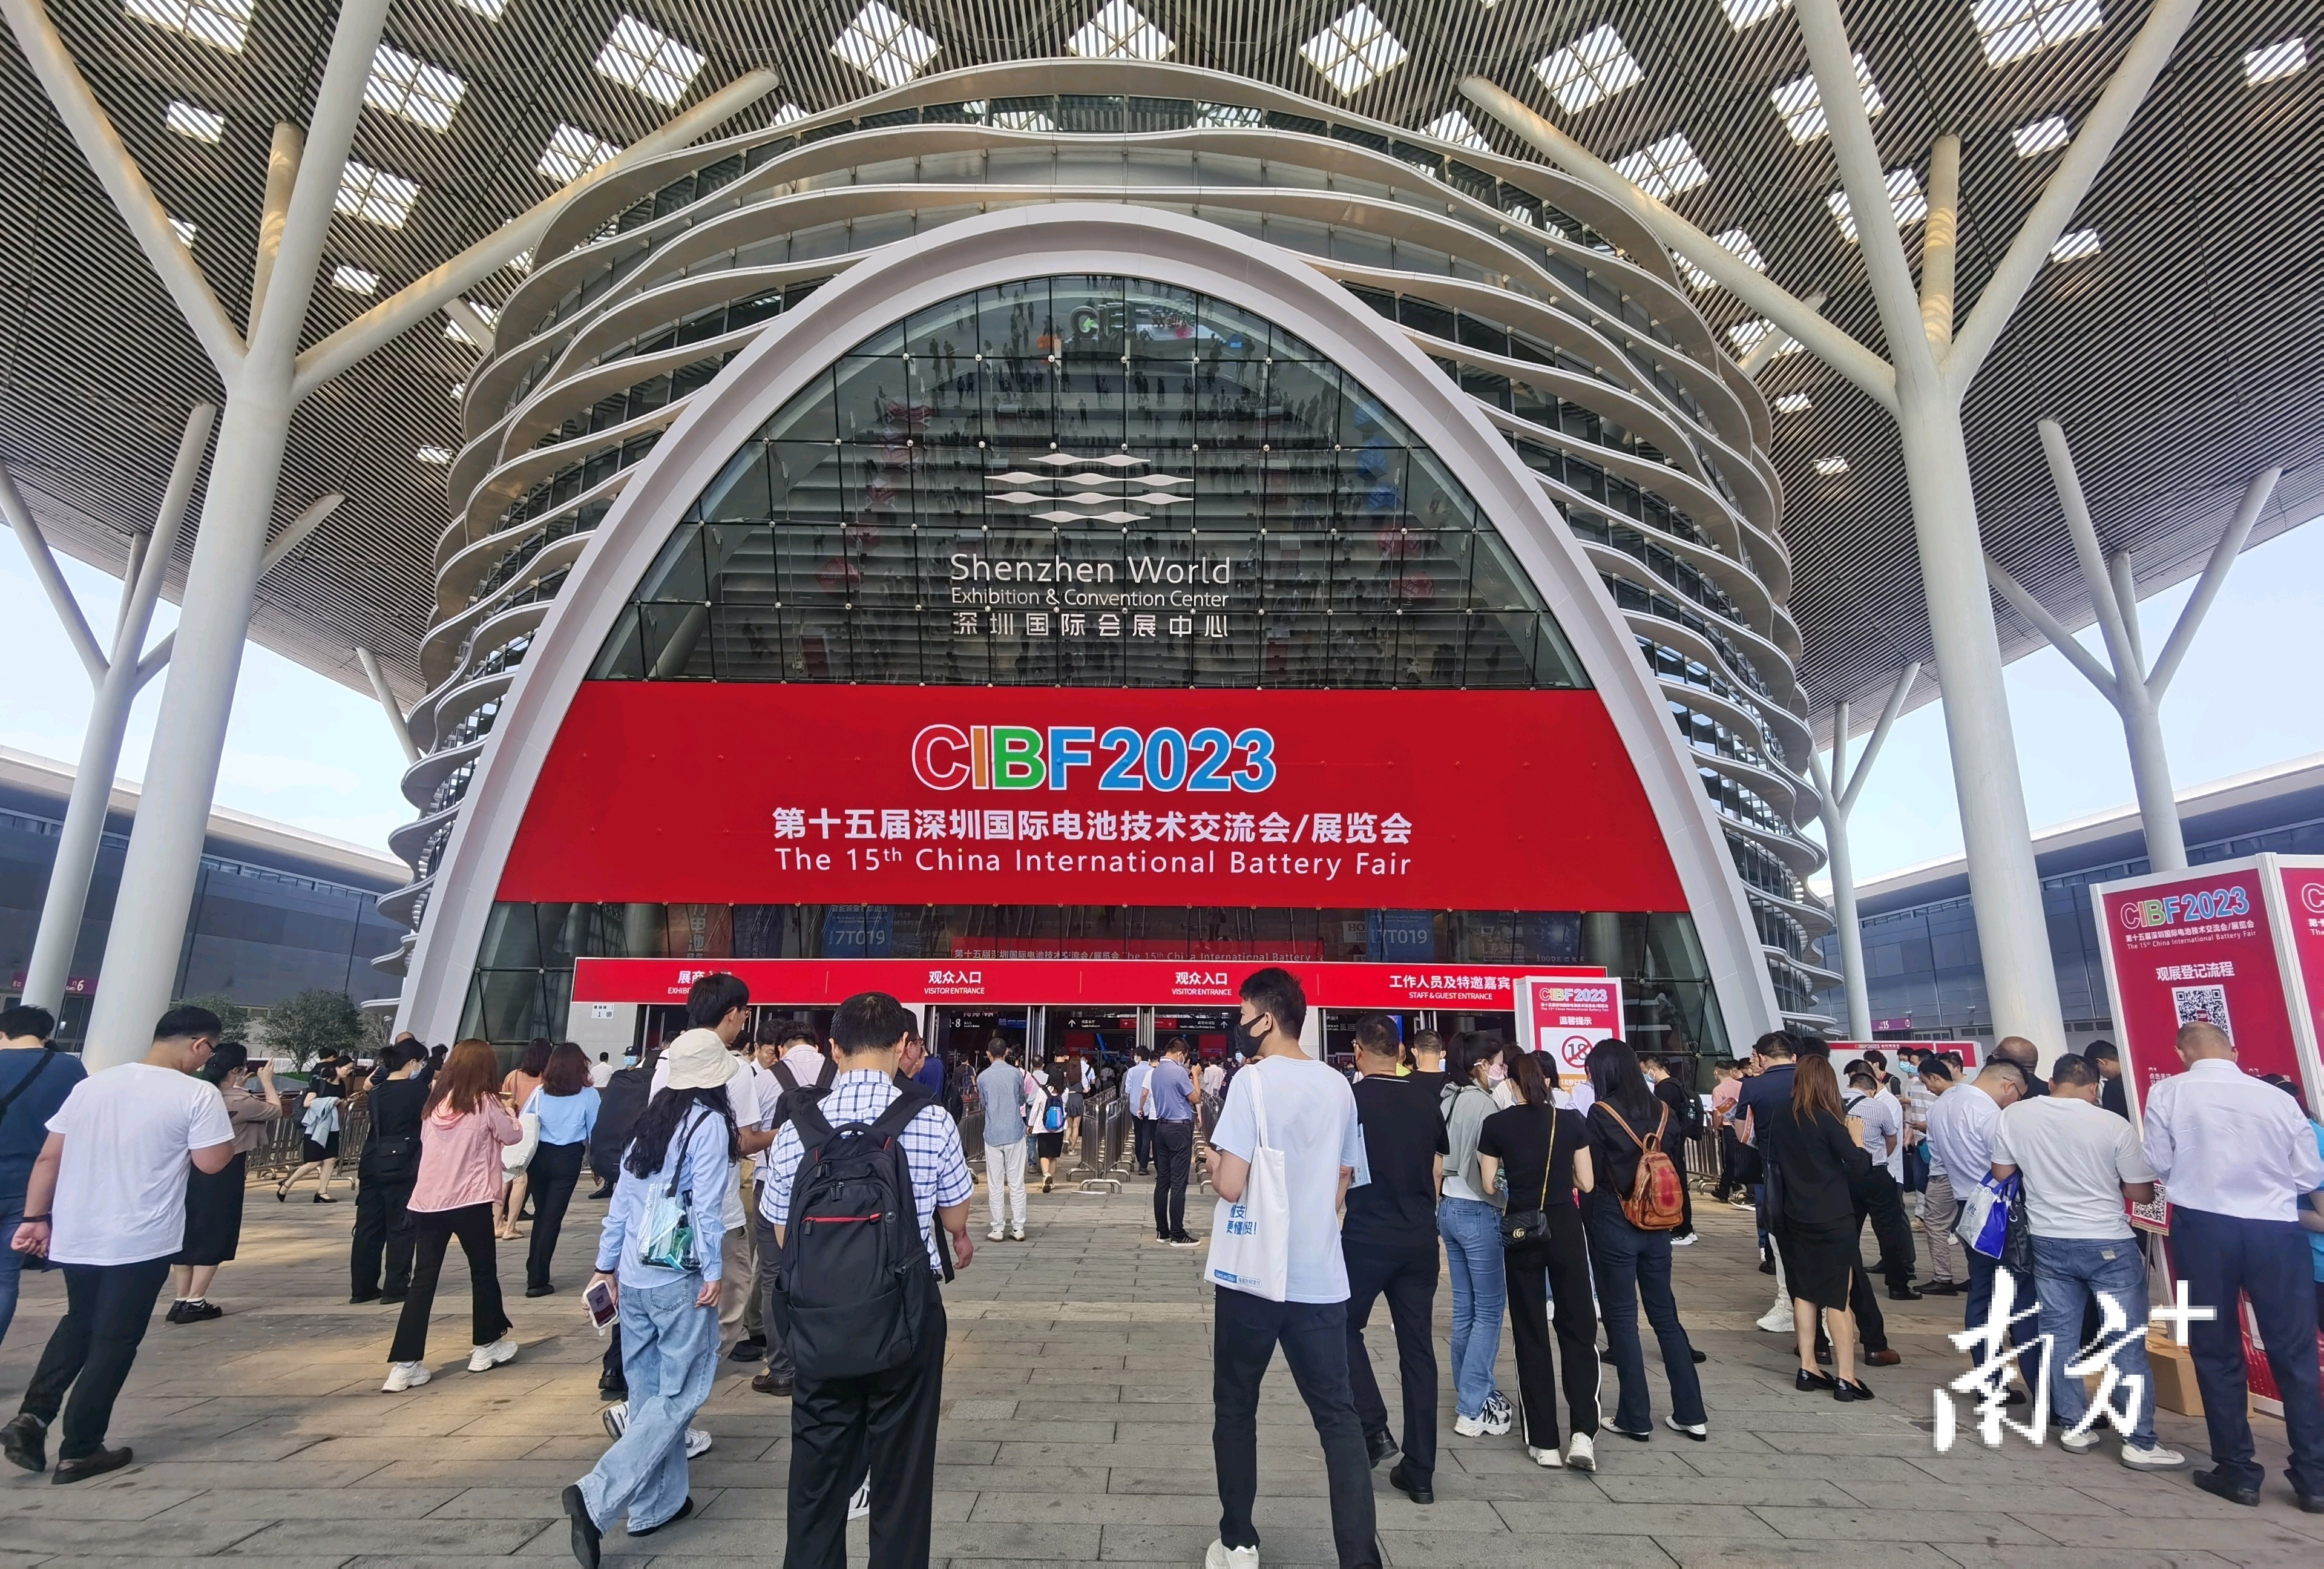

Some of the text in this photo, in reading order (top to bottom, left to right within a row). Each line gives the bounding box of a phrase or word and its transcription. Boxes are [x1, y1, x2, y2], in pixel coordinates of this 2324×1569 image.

[950, 553, 1230, 584] Shenzhen World
[951, 587, 1229, 607] Exhibition & Convention Center
[953, 612, 1229, 638] 深圳国际会展中心
[912, 724, 1277, 793] CIBF2023
[772, 807, 1413, 845] 第十五届深圳国际电池技术交流会/展览会
[775, 847, 1411, 881] The 15th China International Battery Fair
[2120, 886, 2250, 929] CIBF2023
[835, 930, 885, 946] 7T019
[2171, 935, 2214, 945] International
[2216, 932, 2240, 940] Battery
[1122, 952, 1140, 960] he
[1167, 952, 1196, 961] Chia
[1201, 952, 1269, 961] International
[928, 970, 982, 984] 观众入口
[1175, 972, 1228, 985] 观众入口
[2156, 961, 2235, 982] 观展登记流程
[77, 980, 84, 991] 6
[1389, 975, 1511, 990] 工作人员及特邀嘉宾
[1457, 992, 1493, 1001] ENTRANCE
[1539, 988, 1607, 1002] CIBF2023
[1559, 1016, 1592, 1025] 温馨提示
